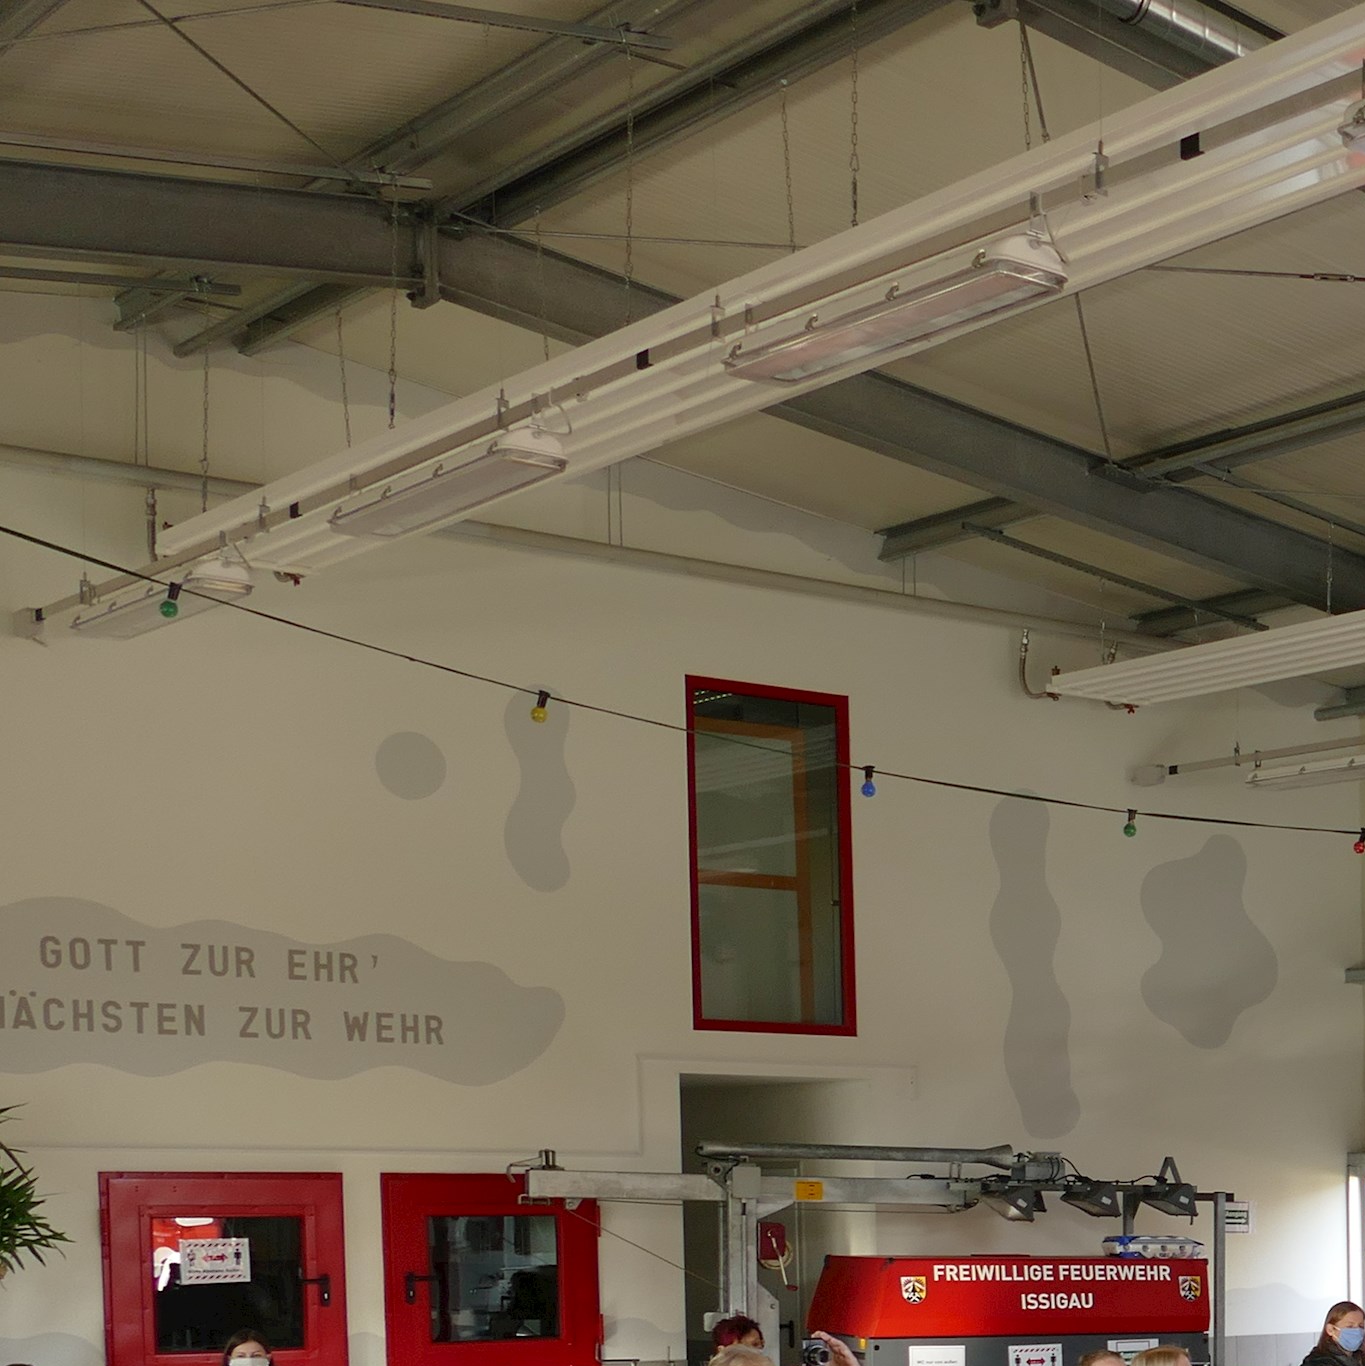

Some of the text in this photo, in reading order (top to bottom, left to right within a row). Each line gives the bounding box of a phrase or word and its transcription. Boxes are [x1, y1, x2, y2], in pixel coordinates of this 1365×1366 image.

[39, 935, 146, 972] GOTT
[181, 942, 256, 978] ZUR
[238, 1006, 312, 1040] ZUR
[343, 1010, 445, 1045] WEHR
[933, 1264, 1171, 1282] FREIWILLIGE FEUERWEHR
[1021, 1293, 1094, 1310] ISSIGAU
